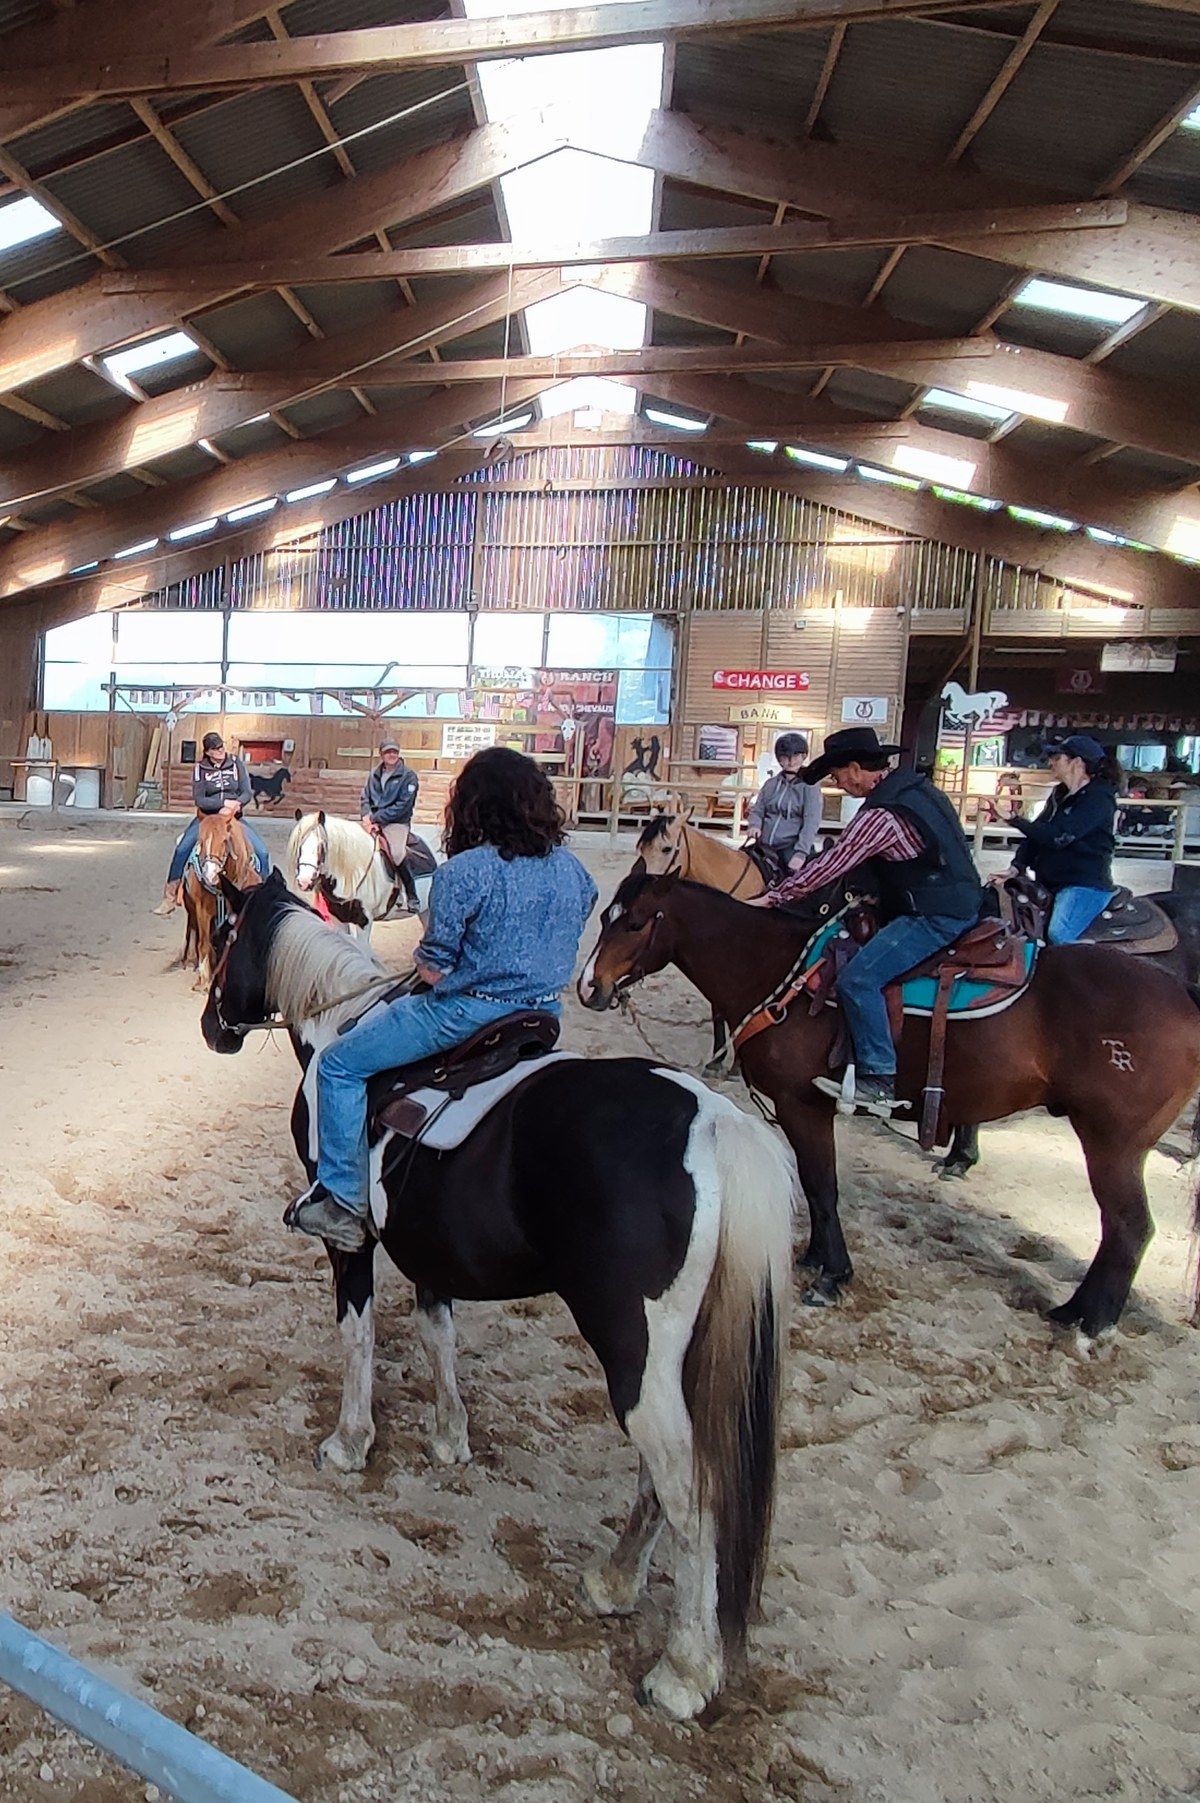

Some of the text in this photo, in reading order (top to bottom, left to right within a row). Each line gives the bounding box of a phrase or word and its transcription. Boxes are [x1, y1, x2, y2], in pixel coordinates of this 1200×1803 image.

[560, 672, 614, 683] RANCH
[727, 673, 797, 689] CHANGE
[740, 708, 780, 721] BANK
